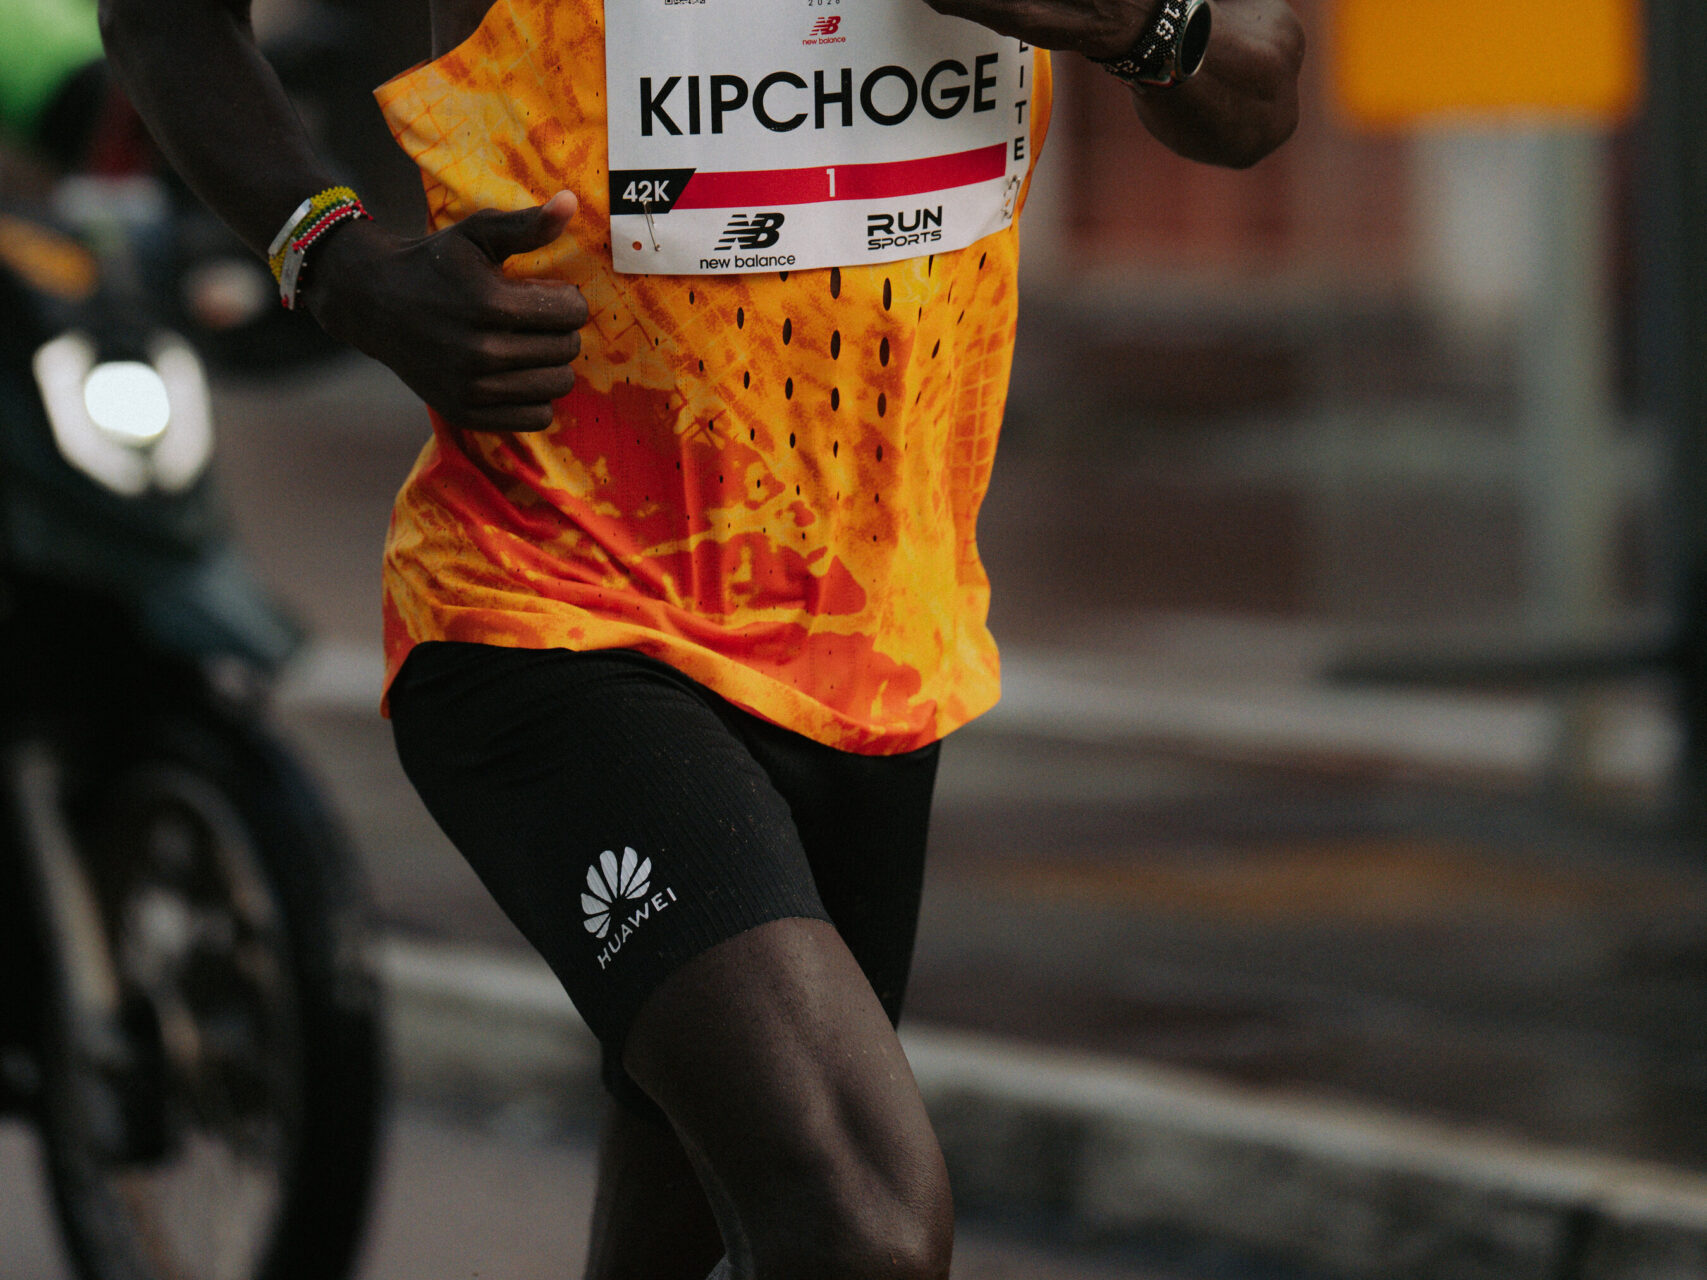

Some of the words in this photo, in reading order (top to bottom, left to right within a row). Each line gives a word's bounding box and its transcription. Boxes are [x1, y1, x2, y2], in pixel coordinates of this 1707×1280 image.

[802, 38, 818, 46] new
[818, 36, 847, 45] balance
[639, 52, 999, 137] KIPCHOGE
[1013, 38, 1029, 161] LITE
[622, 180, 670, 203] 42K
[826, 168, 836, 198] 1
[867, 205, 943, 237] RUN
[867, 229, 943, 251] SPORTS
[700, 255, 731, 270] new
[734, 254, 796, 269] balance
[597, 887, 677, 970] HUAWEI
